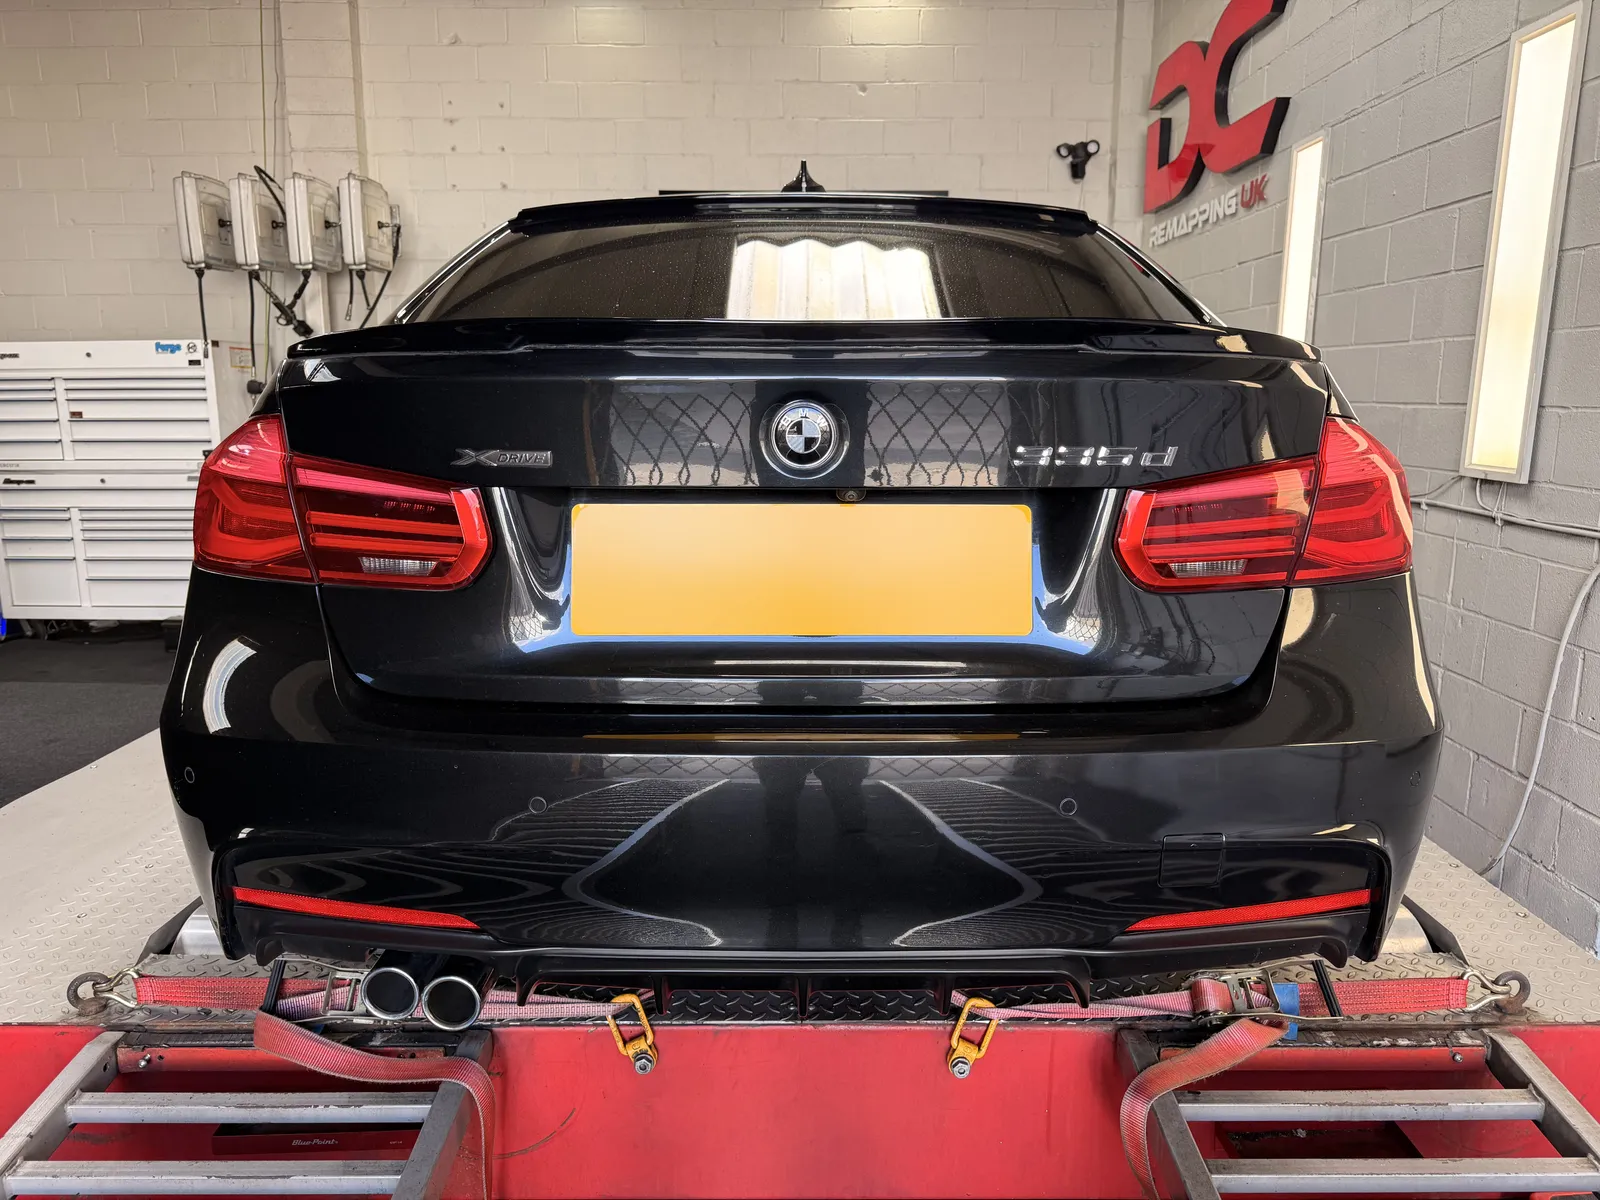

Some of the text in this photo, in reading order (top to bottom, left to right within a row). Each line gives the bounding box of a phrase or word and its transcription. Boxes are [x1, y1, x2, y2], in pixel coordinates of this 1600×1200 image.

[1149, 173, 1269, 248] REMAPPING UK
[778, 408, 828, 428] BMW
